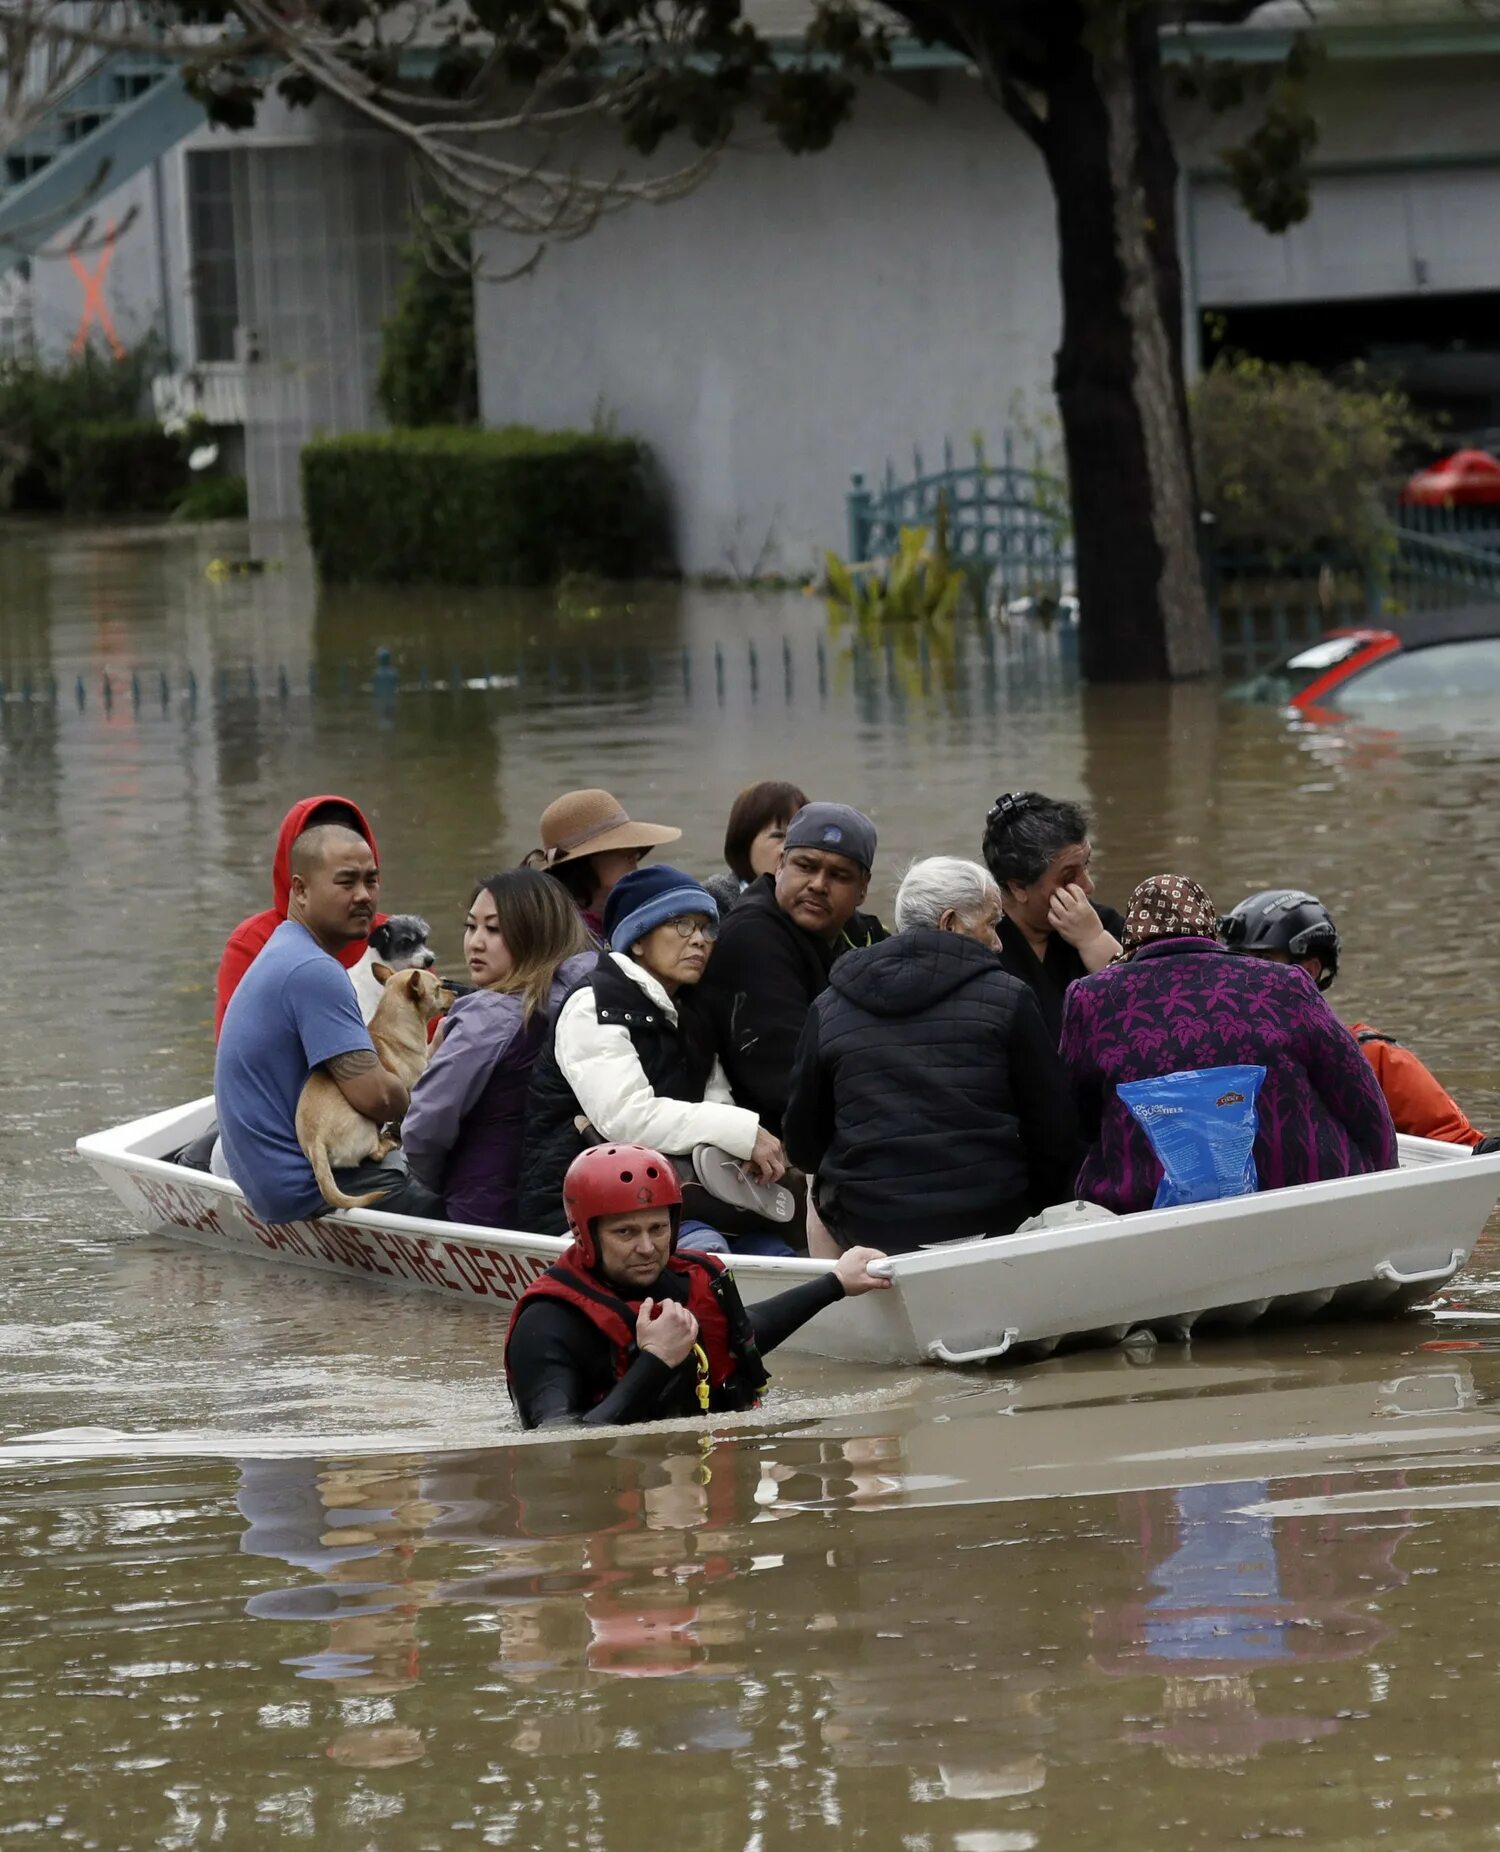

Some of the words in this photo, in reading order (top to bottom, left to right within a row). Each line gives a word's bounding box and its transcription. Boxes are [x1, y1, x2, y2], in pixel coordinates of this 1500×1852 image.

[775, 1191, 787, 1216] GAP
[235, 1200, 317, 1259] SAN
[304, 1219, 394, 1276] JOSE
[369, 1229, 463, 1291] FIRE
